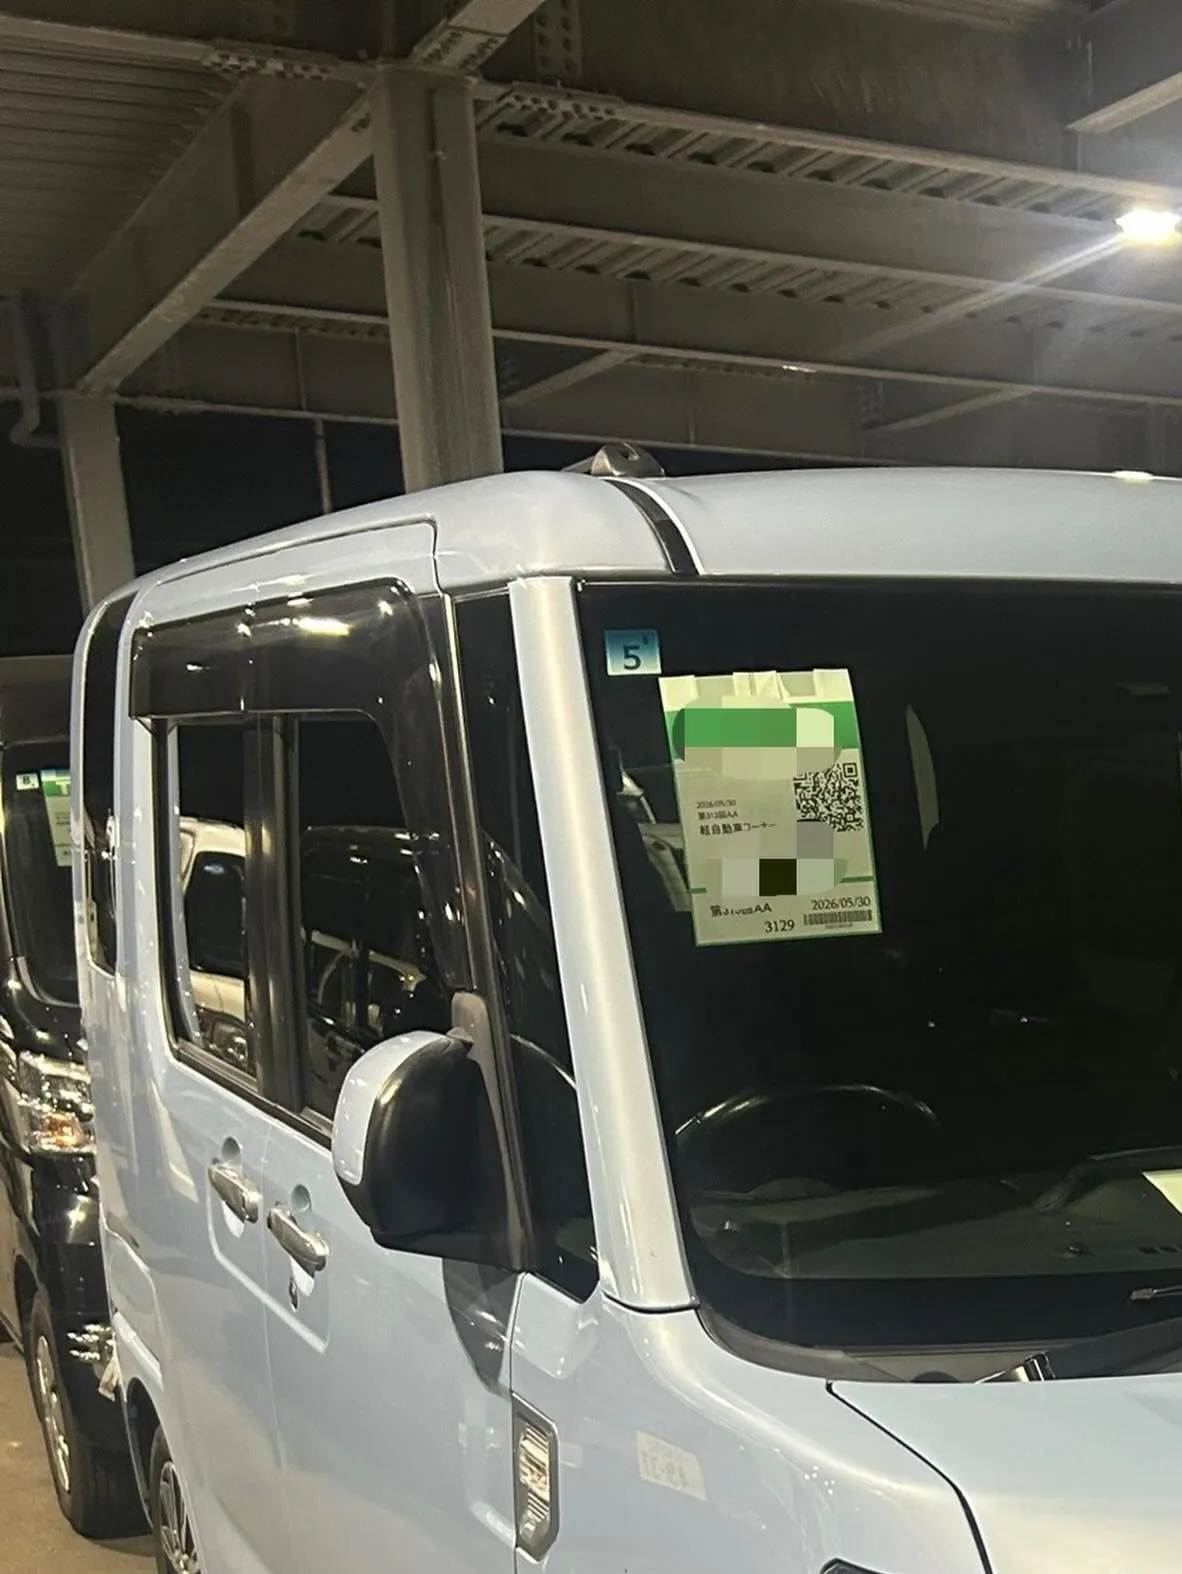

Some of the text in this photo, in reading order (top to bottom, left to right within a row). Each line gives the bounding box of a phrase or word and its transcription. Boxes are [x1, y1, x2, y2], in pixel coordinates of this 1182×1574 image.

[623, 644, 641, 671] 5
[812, 896, 871, 911] 2026/05/30
[764, 919, 795, 933] 3129
